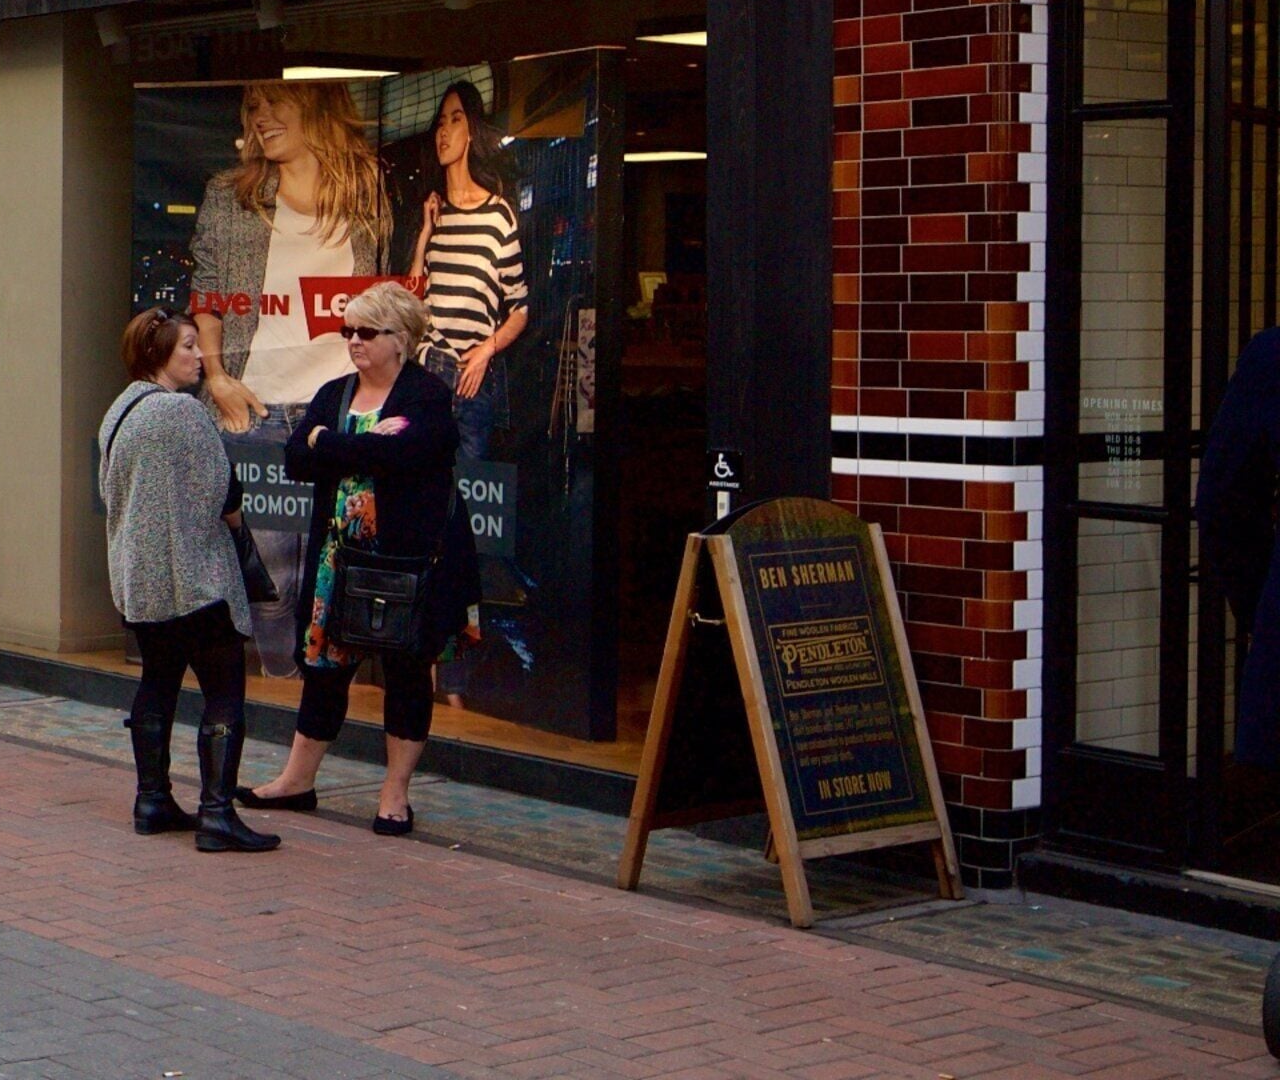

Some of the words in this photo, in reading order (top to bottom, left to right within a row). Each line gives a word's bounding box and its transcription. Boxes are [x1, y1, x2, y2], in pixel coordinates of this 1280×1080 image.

[261, 294, 290, 316] IN
[1083, 397, 1128, 409] OPENING
[1132, 400, 1163, 411] TIMES
[1104, 434, 1121, 444] WED
[1106, 445, 1121, 456] THU
[759, 566, 788, 589] BEN
[791, 560, 856, 587] SHERMAN
[781, 636, 868, 675] PENDLETON
[818, 779, 832, 800] IN
[833, 774, 867, 798] STORE
[866, 770, 893, 792] NOW
